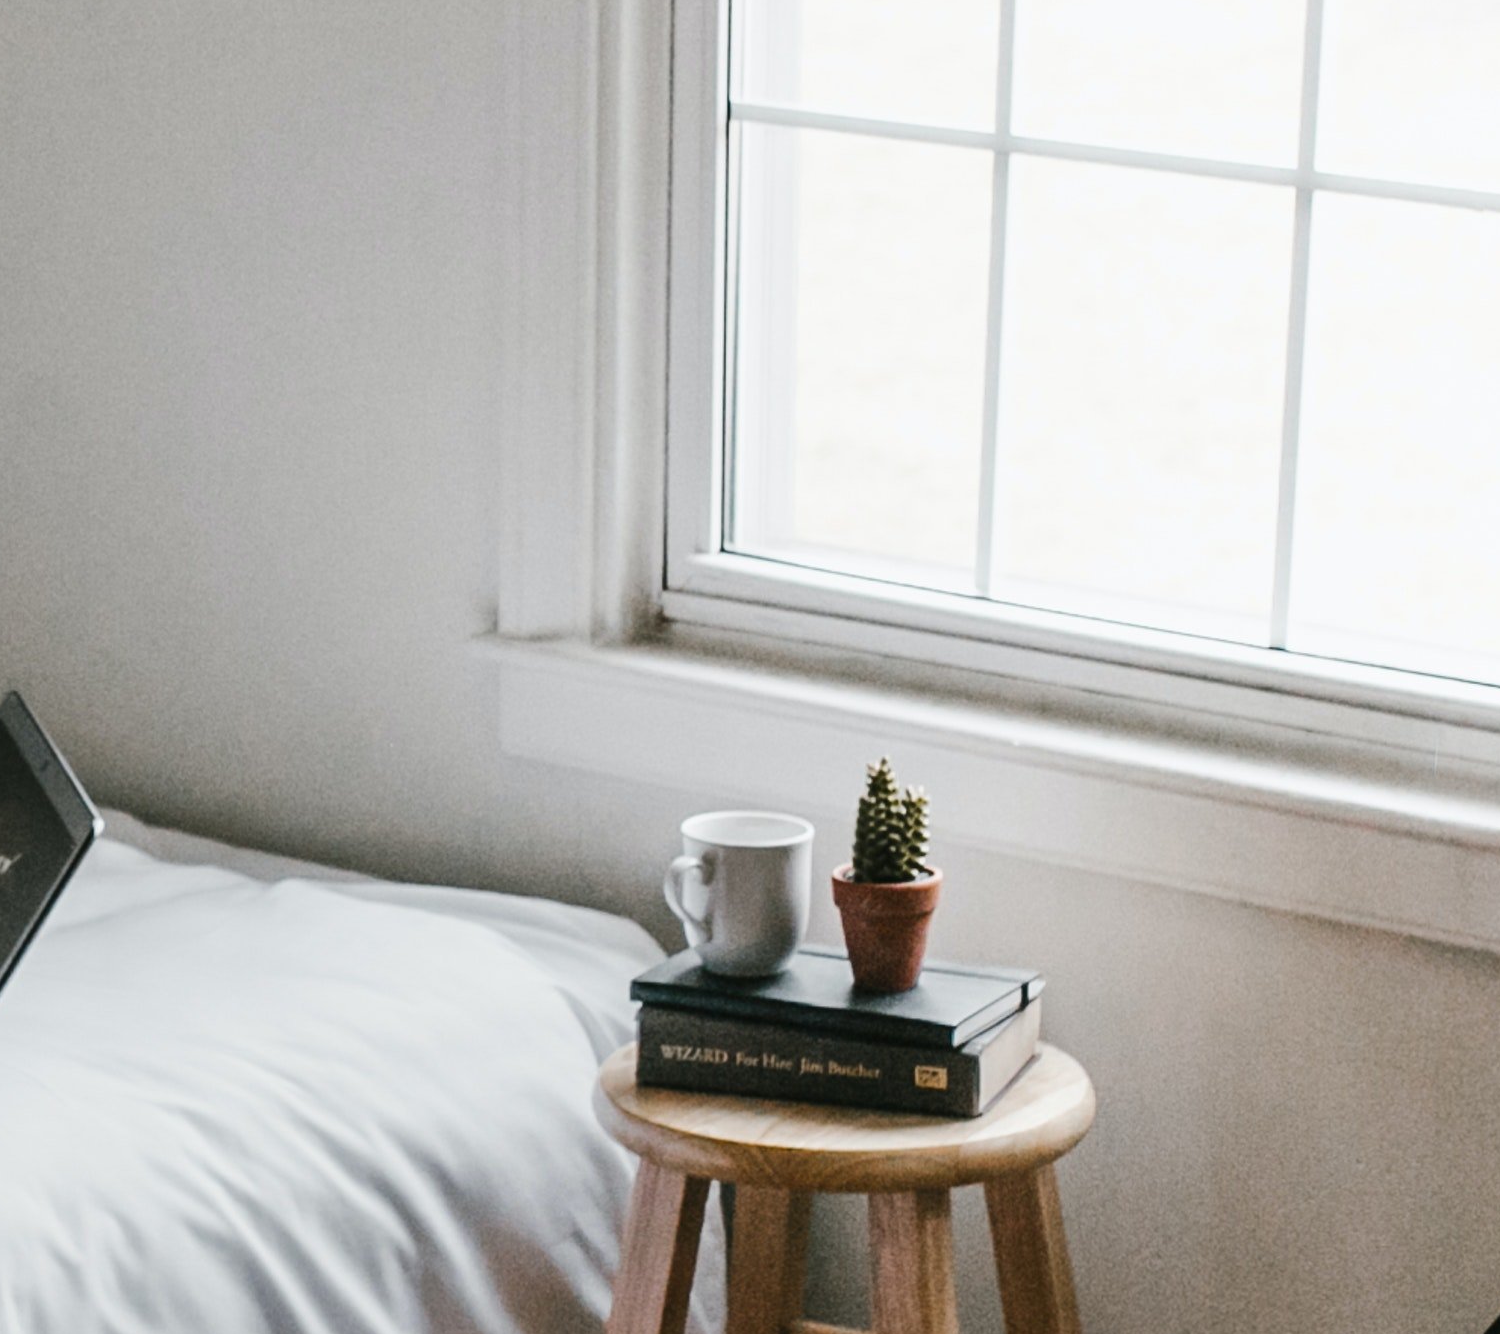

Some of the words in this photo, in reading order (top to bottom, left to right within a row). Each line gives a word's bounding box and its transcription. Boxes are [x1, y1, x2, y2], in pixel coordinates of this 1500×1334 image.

[660, 1045, 729, 1064] WIZARD
[735, 1051, 760, 1067] For
[800, 1057, 823, 1075] Jim
